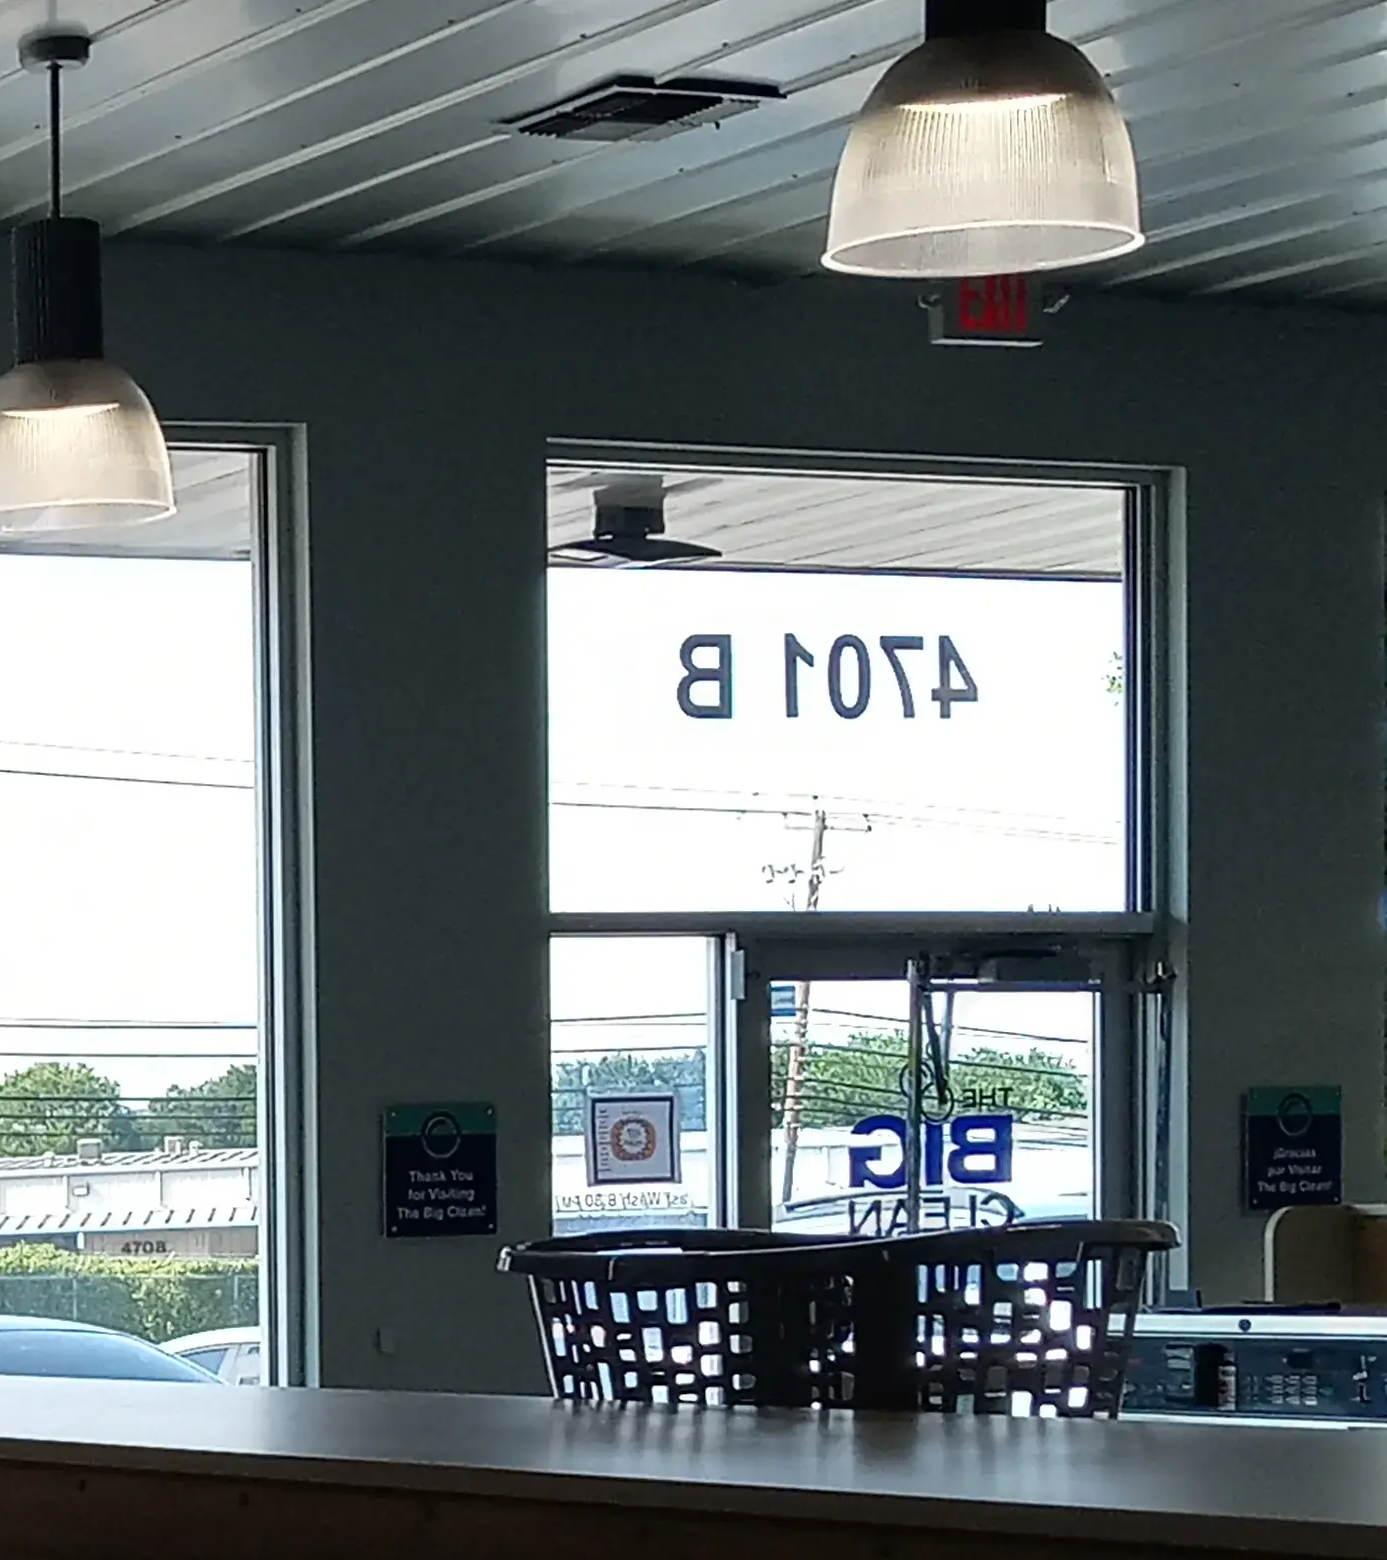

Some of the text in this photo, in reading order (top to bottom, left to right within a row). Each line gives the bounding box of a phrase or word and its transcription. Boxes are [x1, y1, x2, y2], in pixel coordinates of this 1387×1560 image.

[408, 1169, 475, 1183] Thank You
[407, 1187, 475, 1202] for Visiting
[1257, 1181, 1277, 1192] The
[1279, 1181, 1297, 1194] Big
[396, 1204, 487, 1221] The Big Clean!
